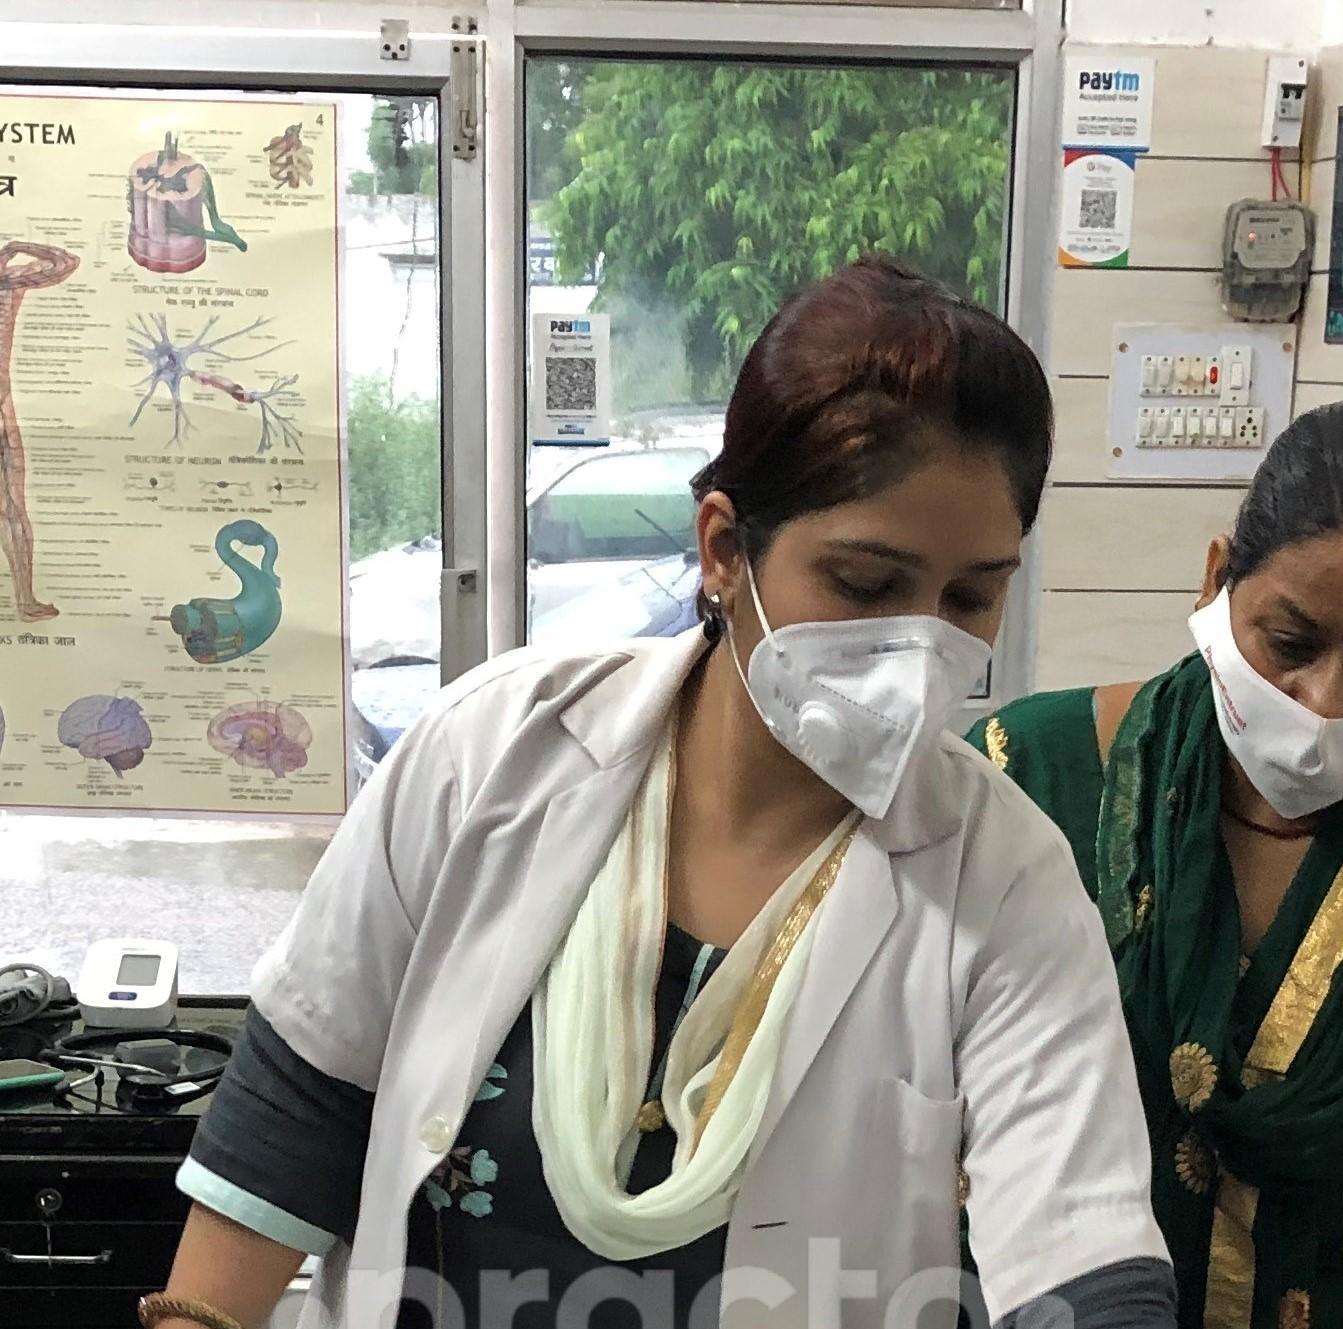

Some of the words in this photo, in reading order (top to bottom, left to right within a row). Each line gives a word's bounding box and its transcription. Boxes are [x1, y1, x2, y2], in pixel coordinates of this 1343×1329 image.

[315, 113, 324, 125] 4
[132, 285, 179, 294] STRUCTURE
[197, 287, 211, 296] THE
[215, 287, 242, 297] SPINAL
[245, 289, 269, 298] CORD
